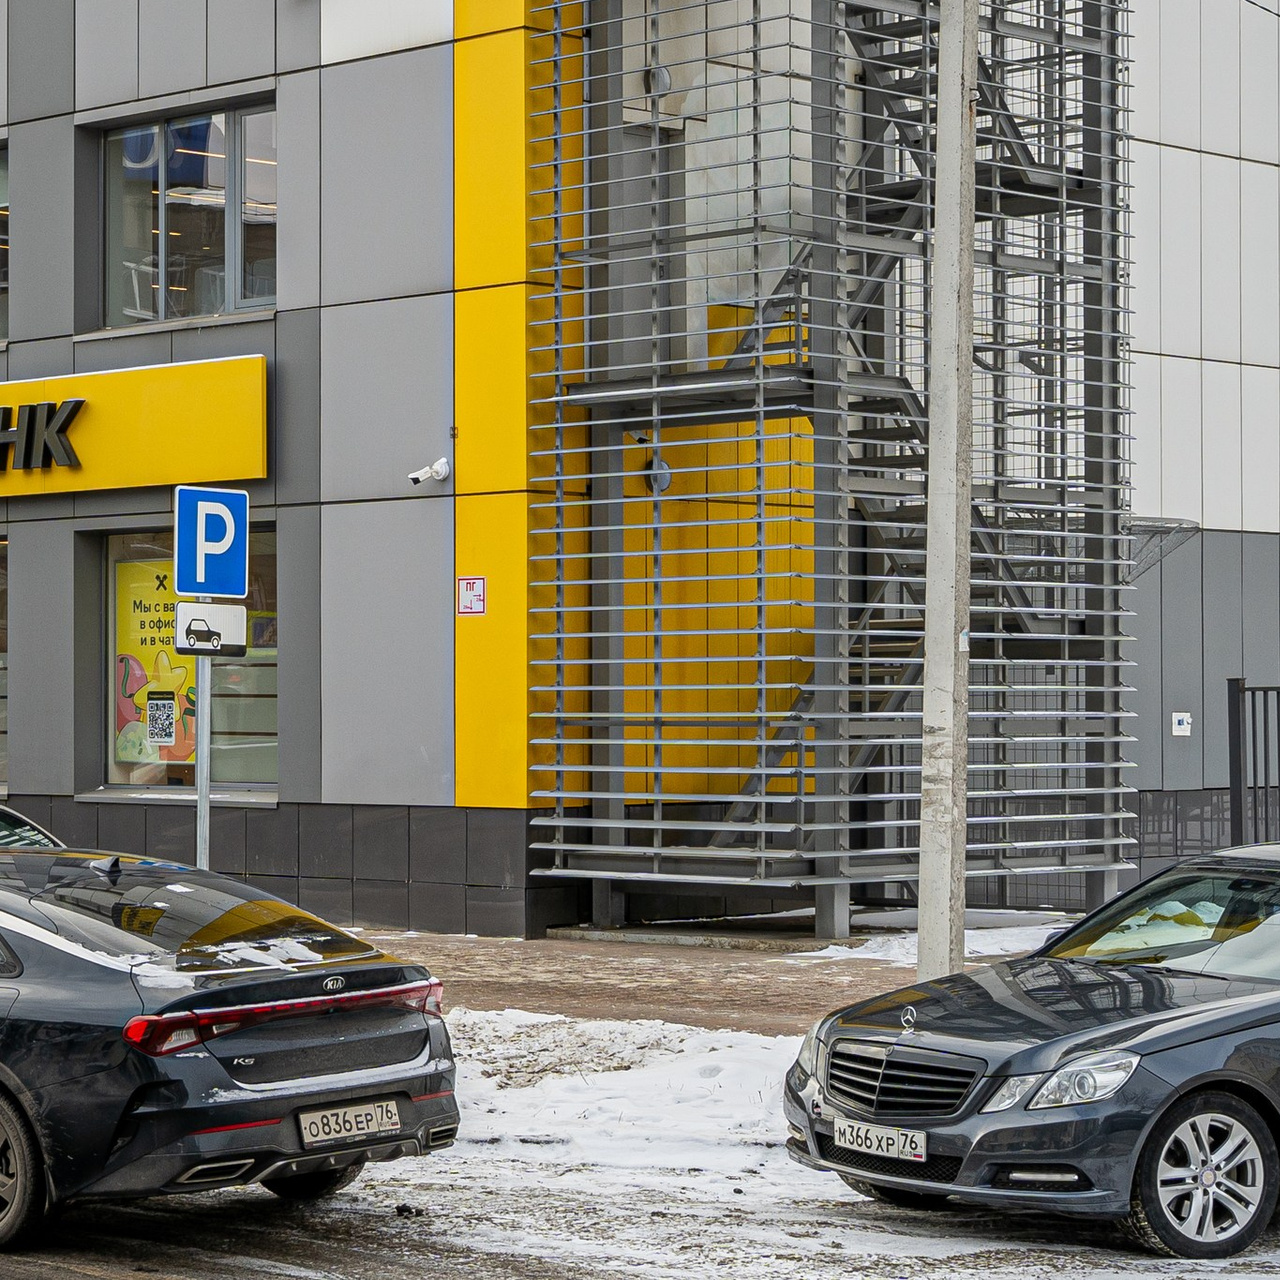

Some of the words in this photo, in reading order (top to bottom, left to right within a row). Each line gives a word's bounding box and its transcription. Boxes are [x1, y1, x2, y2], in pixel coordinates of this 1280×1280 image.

[196, 501, 235, 583] P
[133, 599, 151, 613] Мы
[154, 603, 160, 612] с
[140, 620, 146, 629] в
[149, 617, 175, 633] офис
[141, 637, 147, 645] и
[150, 637, 156, 645] в
[159, 636, 175, 645] чат
[326, 978, 343, 990] KIA
[376, 1103, 393, 1121] 76
[900, 1133, 918, 1150] 76
[900, 1149, 913, 1158] RUS
